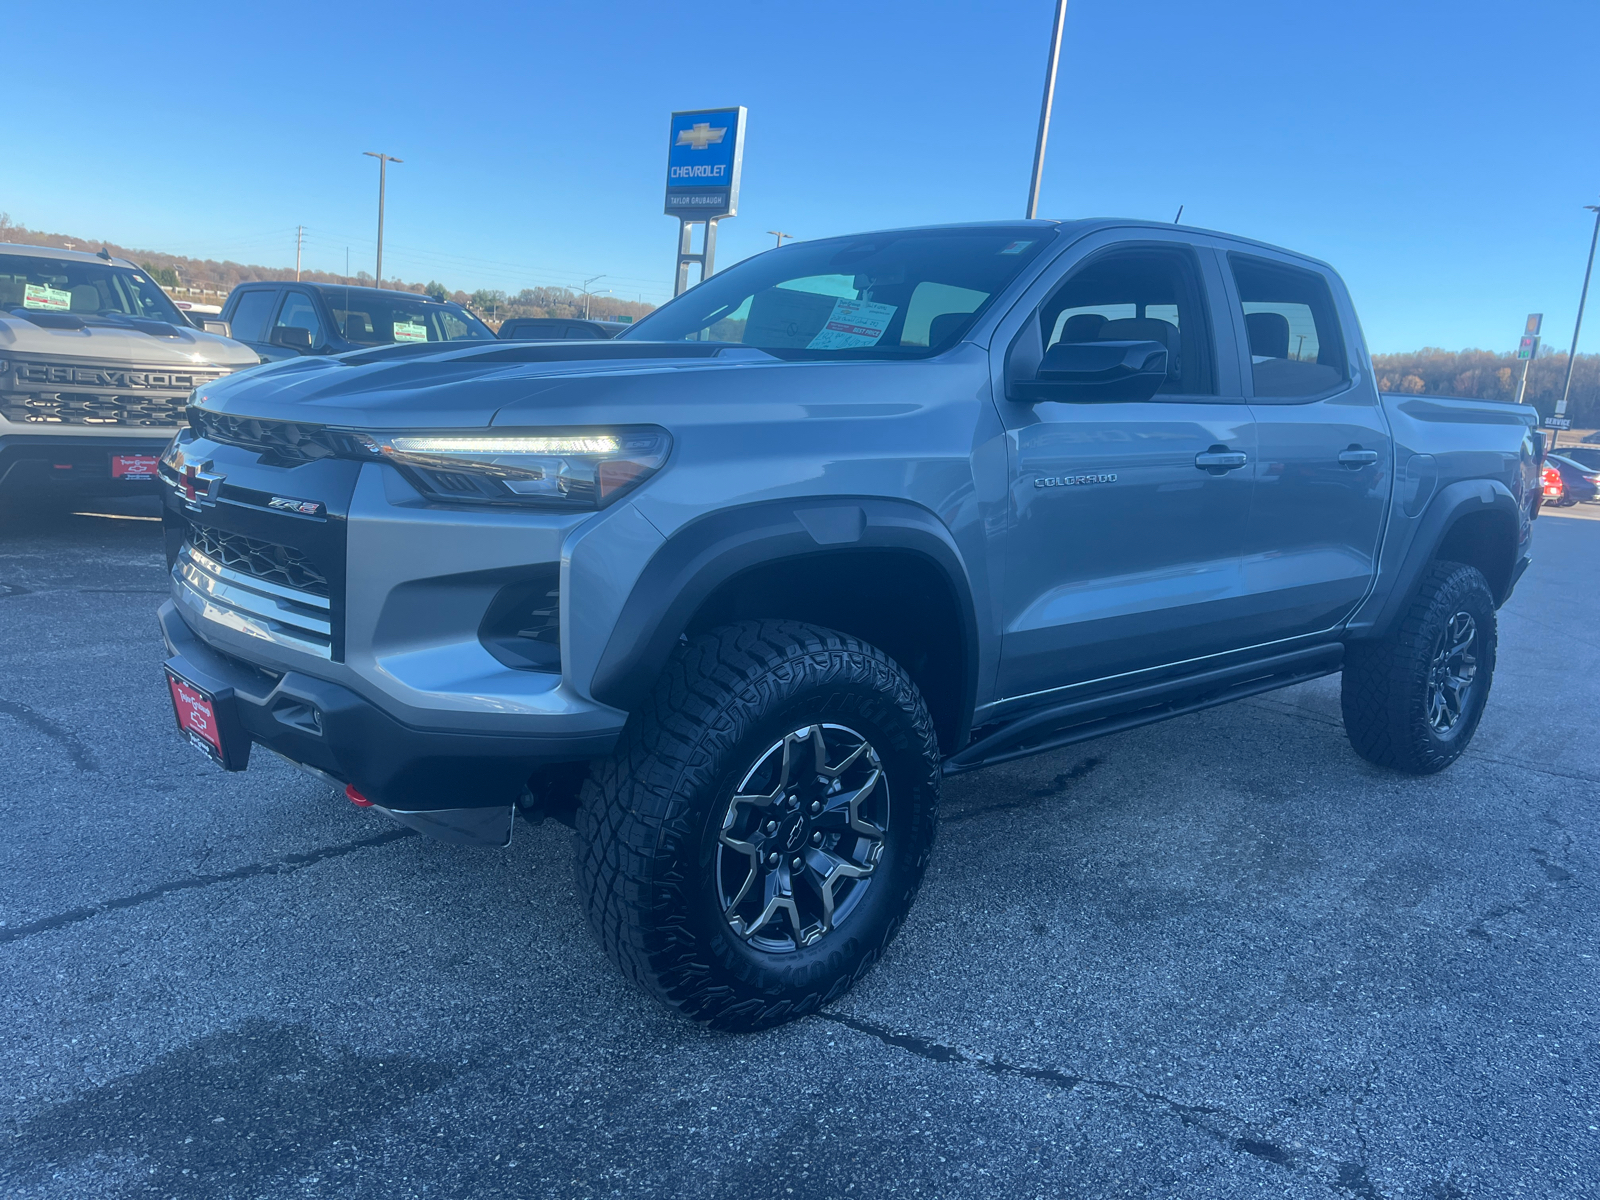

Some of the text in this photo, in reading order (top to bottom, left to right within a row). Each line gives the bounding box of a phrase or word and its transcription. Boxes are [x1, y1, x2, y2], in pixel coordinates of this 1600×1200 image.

[671, 165, 726, 178] CHEVROLET
[671, 196, 722, 205] TAYLOR GRUBAUGH
[25, 362, 222, 388] CHEVROLE
[1544, 416, 1571, 427] SERVICE
[1034, 474, 1118, 487] COLORADO
[268, 496, 320, 514] ZR2
